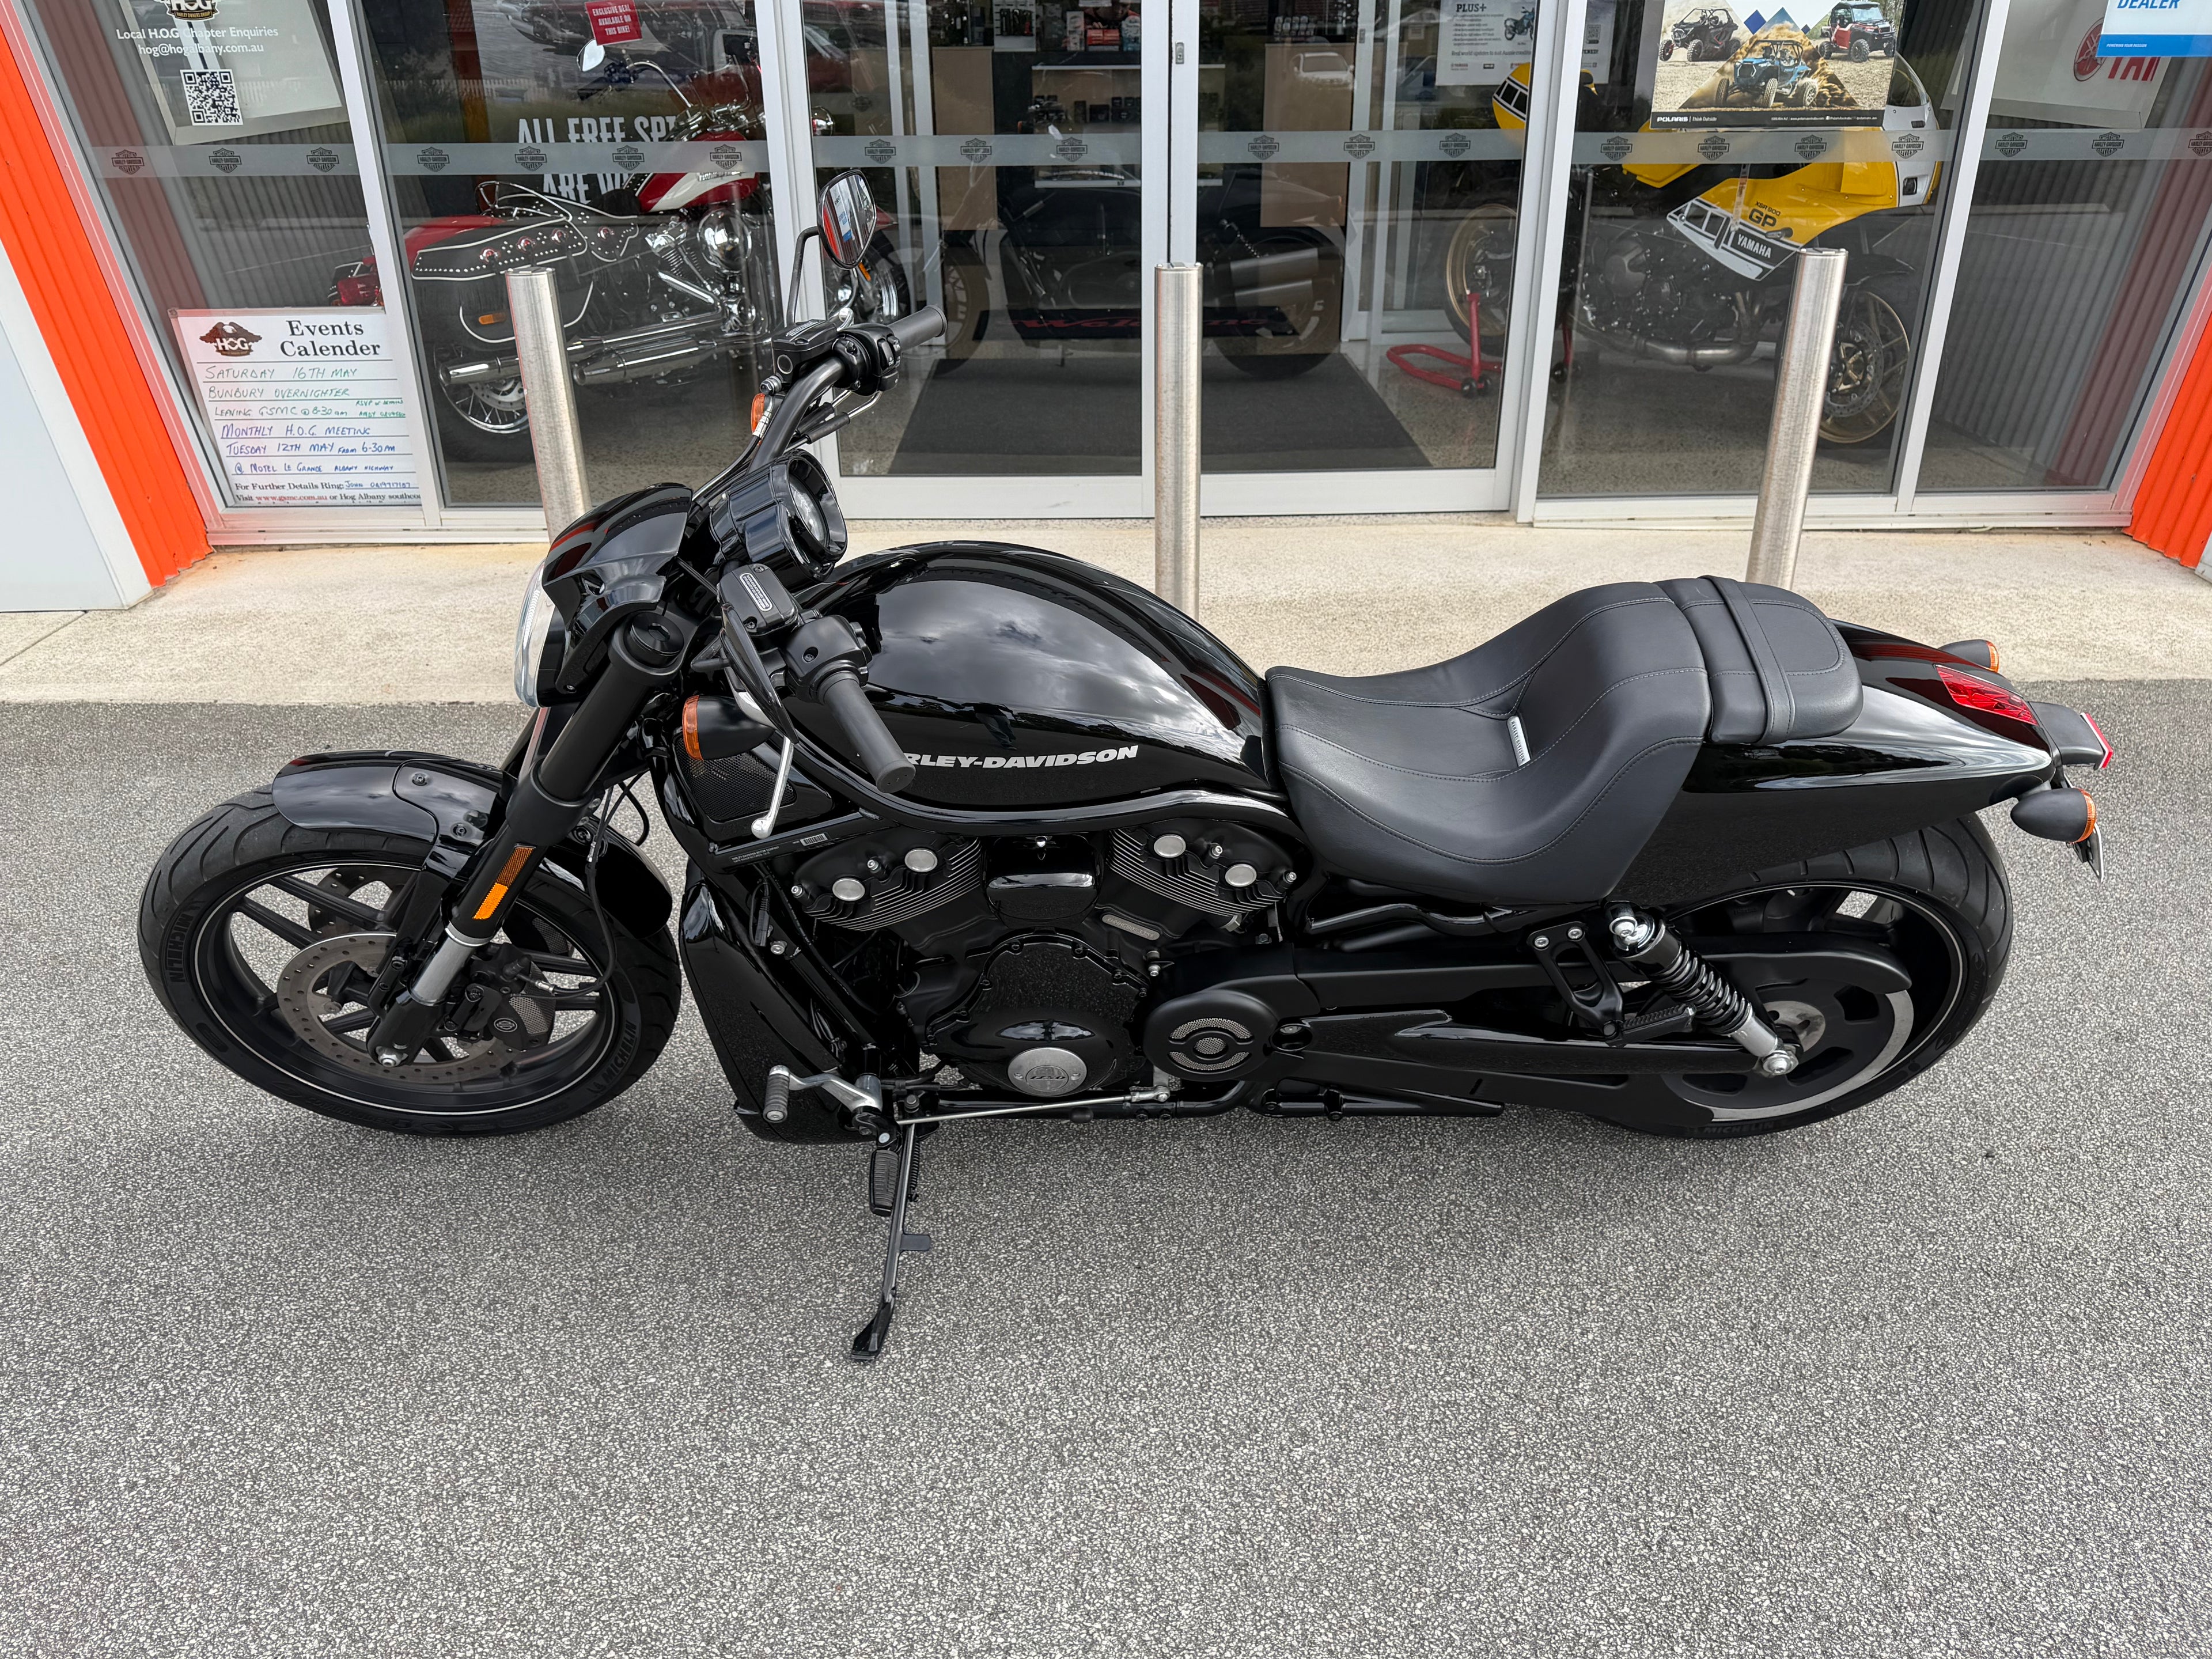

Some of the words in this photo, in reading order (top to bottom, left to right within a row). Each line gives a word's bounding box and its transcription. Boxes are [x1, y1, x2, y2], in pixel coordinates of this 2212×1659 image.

[592, 6, 618, 16] EXCLUSIVE
[618, 4, 631, 13] DEAL
[1456, 3, 1487, 13] PLUS+
[2117, 0, 2180, 9] DEALER
[599, 16, 624, 26] AVAILABLE
[116, 29, 146, 40] Local
[150, 28, 179, 39] H.O.G
[184, 27, 226, 40] Chapter
[229, 26, 279, 41] Enquiries
[605, 27, 617, 36] THIS
[617, 25, 631, 33] BIKE!
[138, 43, 264, 56] hog@hogalbany.com.au
[567, 116, 626, 143] FREE
[1756, 201, 1767, 210] XSR
[1768, 206, 1781, 217] 900
[1749, 208, 1777, 227] GP
[1737, 233, 1771, 259] YAMAHA
[286, 320, 364, 336] Events
[215, 337, 249, 351] HOG
[280, 339, 380, 357] Calender
[205, 365, 275, 380] SATURDAY
[293, 367, 325, 380] 16TH
[331, 368, 358, 378] MAY
[209, 385, 264, 399] BUNBURY
[274, 388, 350, 399] OVERNIGHTER
[215, 406, 253, 416] LEAVING
[259, 406, 298, 416] GSMC
[312, 406, 332, 415] 8-30
[221, 423, 273, 438] MONTHLY
[285, 423, 317, 437] H.O.G.
[324, 426, 370, 435] MEETING
[226, 441, 267, 455] TUESDAY
[277, 442, 301, 452] 12TH
[309, 442, 334, 452] MAY
[235, 462, 244, 475] @
[297, 462, 323, 472] GRANDE
[252, 482, 286, 490] Further
[288, 482, 319, 490] Details
[321, 482, 344, 491] Ring:
[339, 493, 356, 501] Hog
[358, 493, 386, 501] Albany
[903, 745, 1138, 768] RLEY-DAVIDSON
[165, 912, 194, 983] MICHELIN
[603, 1021, 638, 1084] MICHELIN
[1705, 1123, 1772, 1134] MICHELIN
